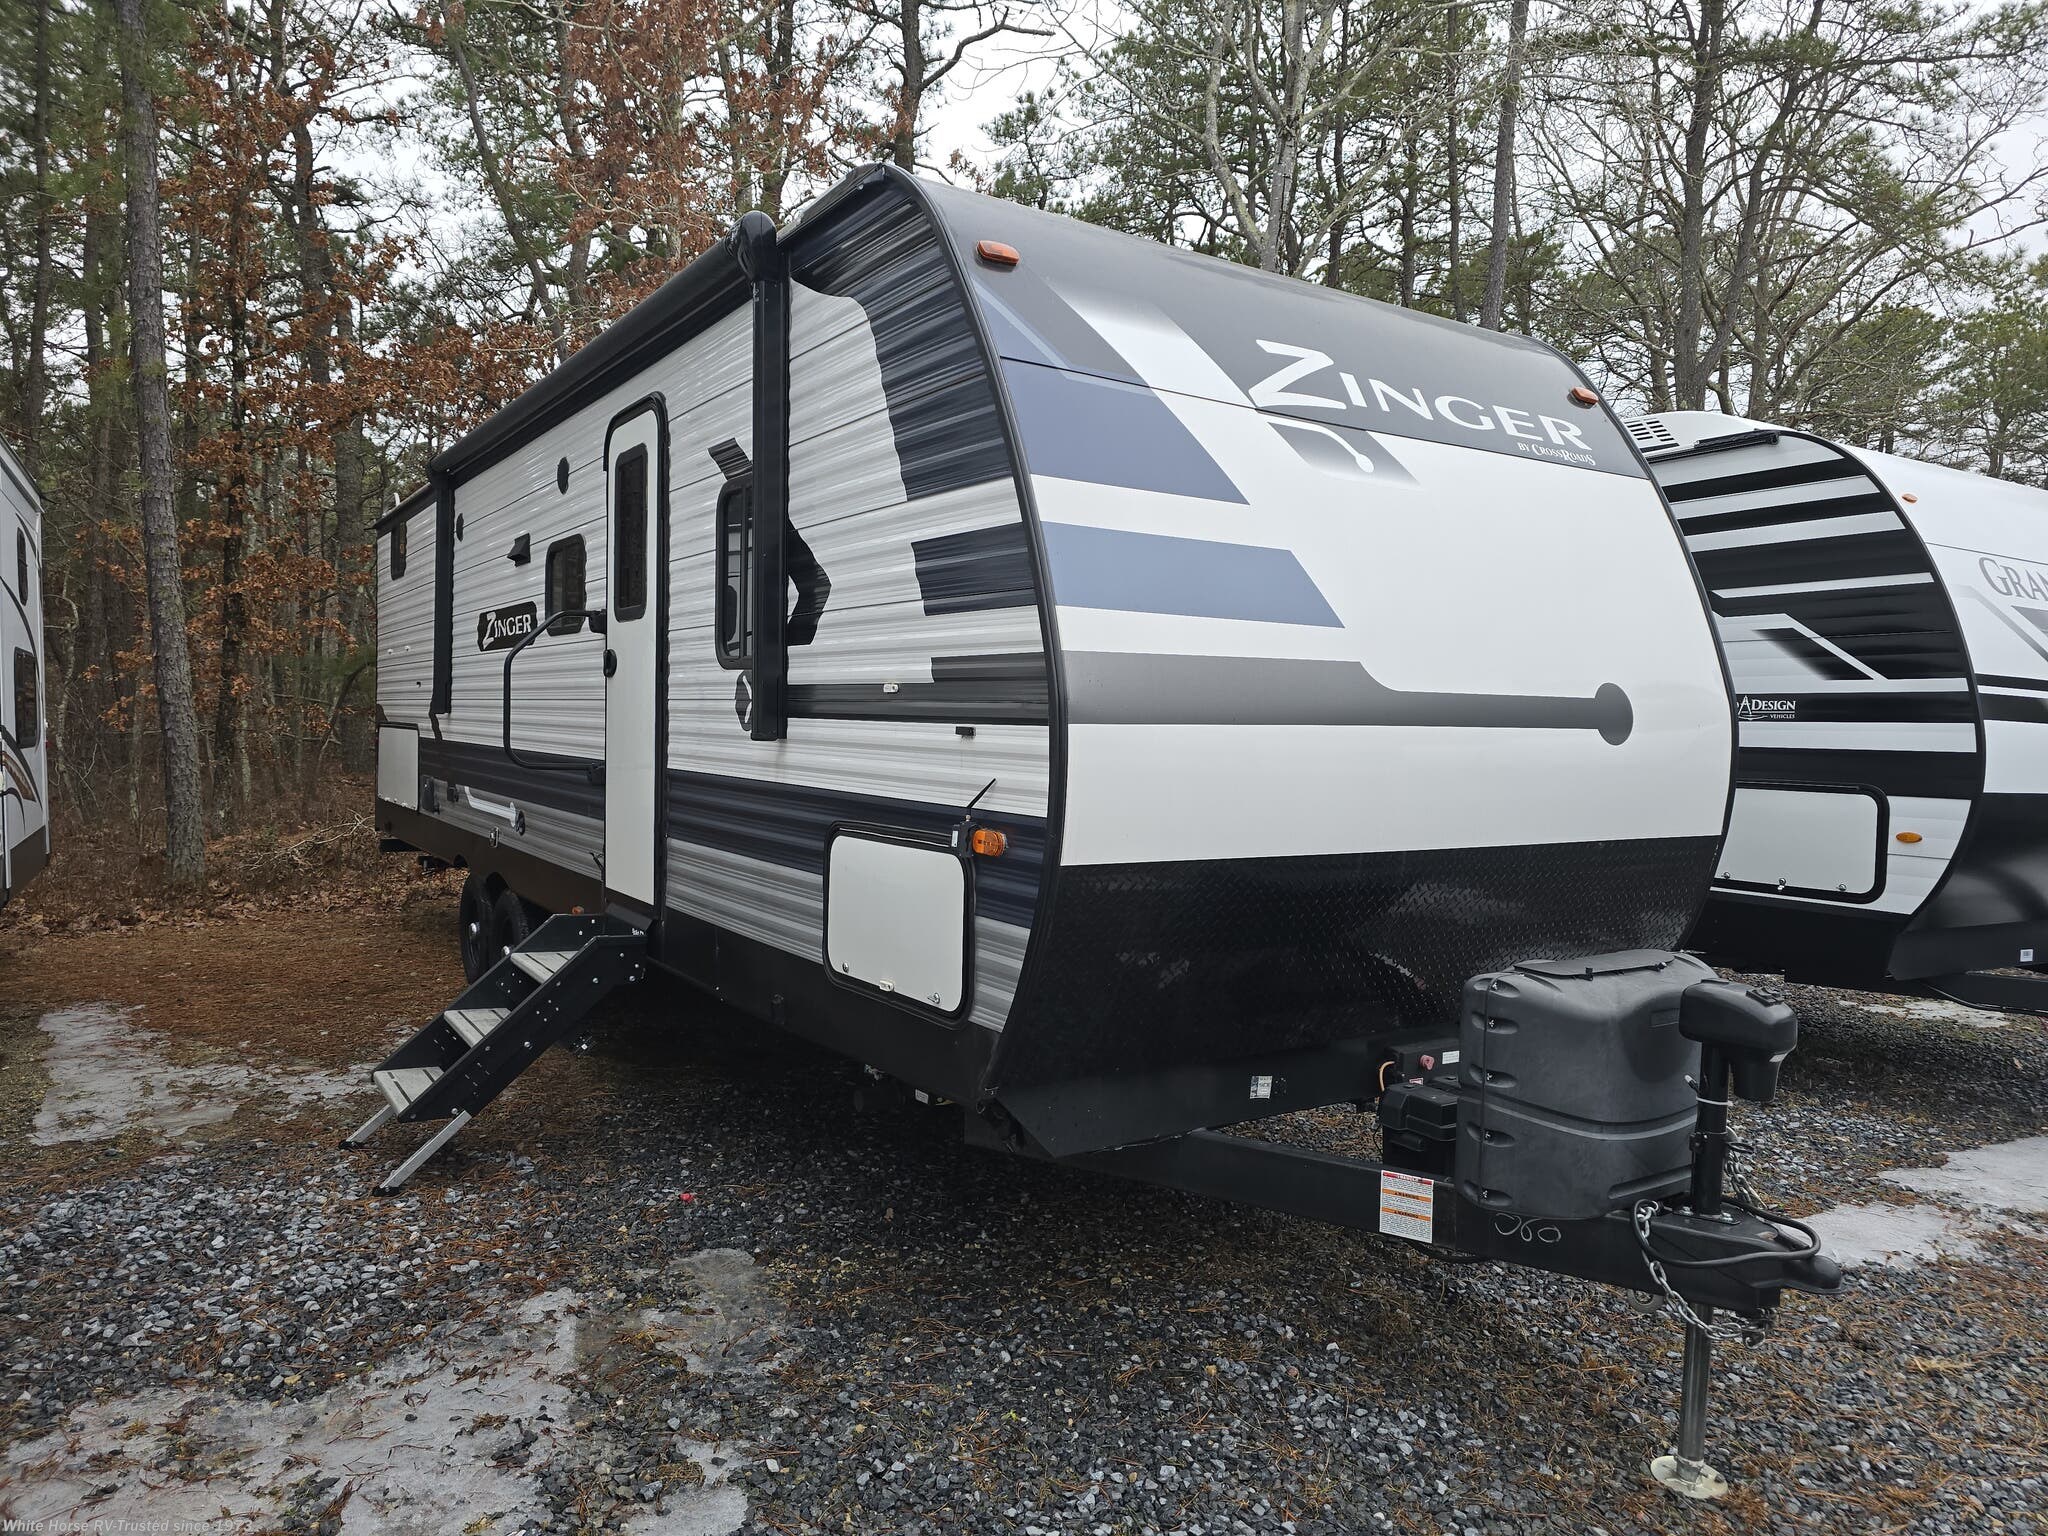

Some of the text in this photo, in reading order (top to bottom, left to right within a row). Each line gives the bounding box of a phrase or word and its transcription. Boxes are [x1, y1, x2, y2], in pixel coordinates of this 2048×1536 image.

[1248, 338, 1592, 451] ZINGER
[1517, 442, 1530, 452] BY
[482, 611, 532, 650] ZINGER
